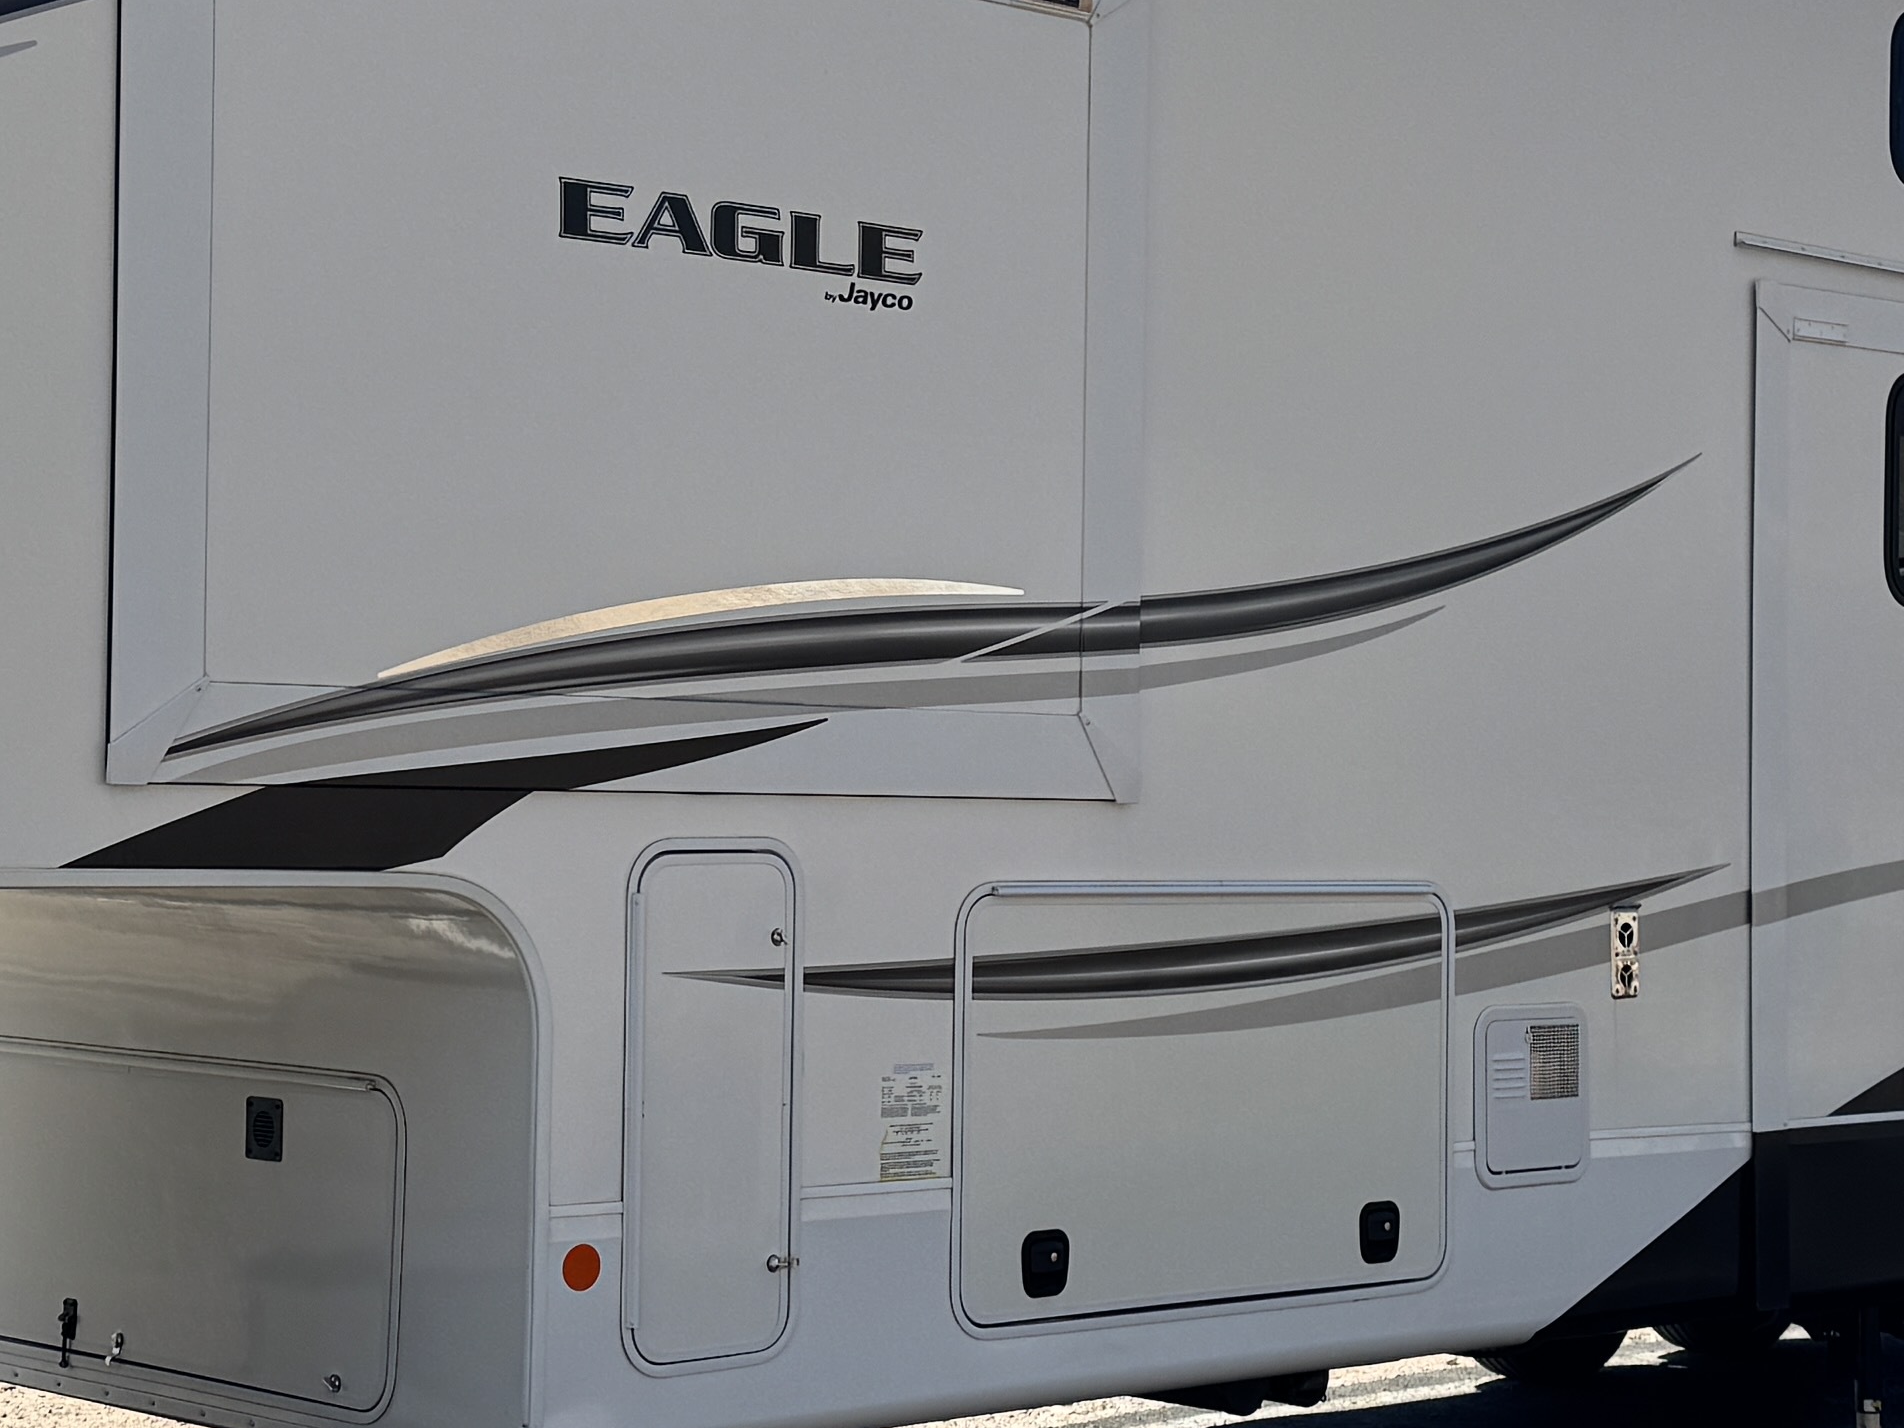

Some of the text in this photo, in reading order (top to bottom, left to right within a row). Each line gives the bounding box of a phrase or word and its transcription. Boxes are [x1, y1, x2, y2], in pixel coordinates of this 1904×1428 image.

[558, 176, 923, 285] EAGLE
[824, 282, 914, 311] by Jayco
